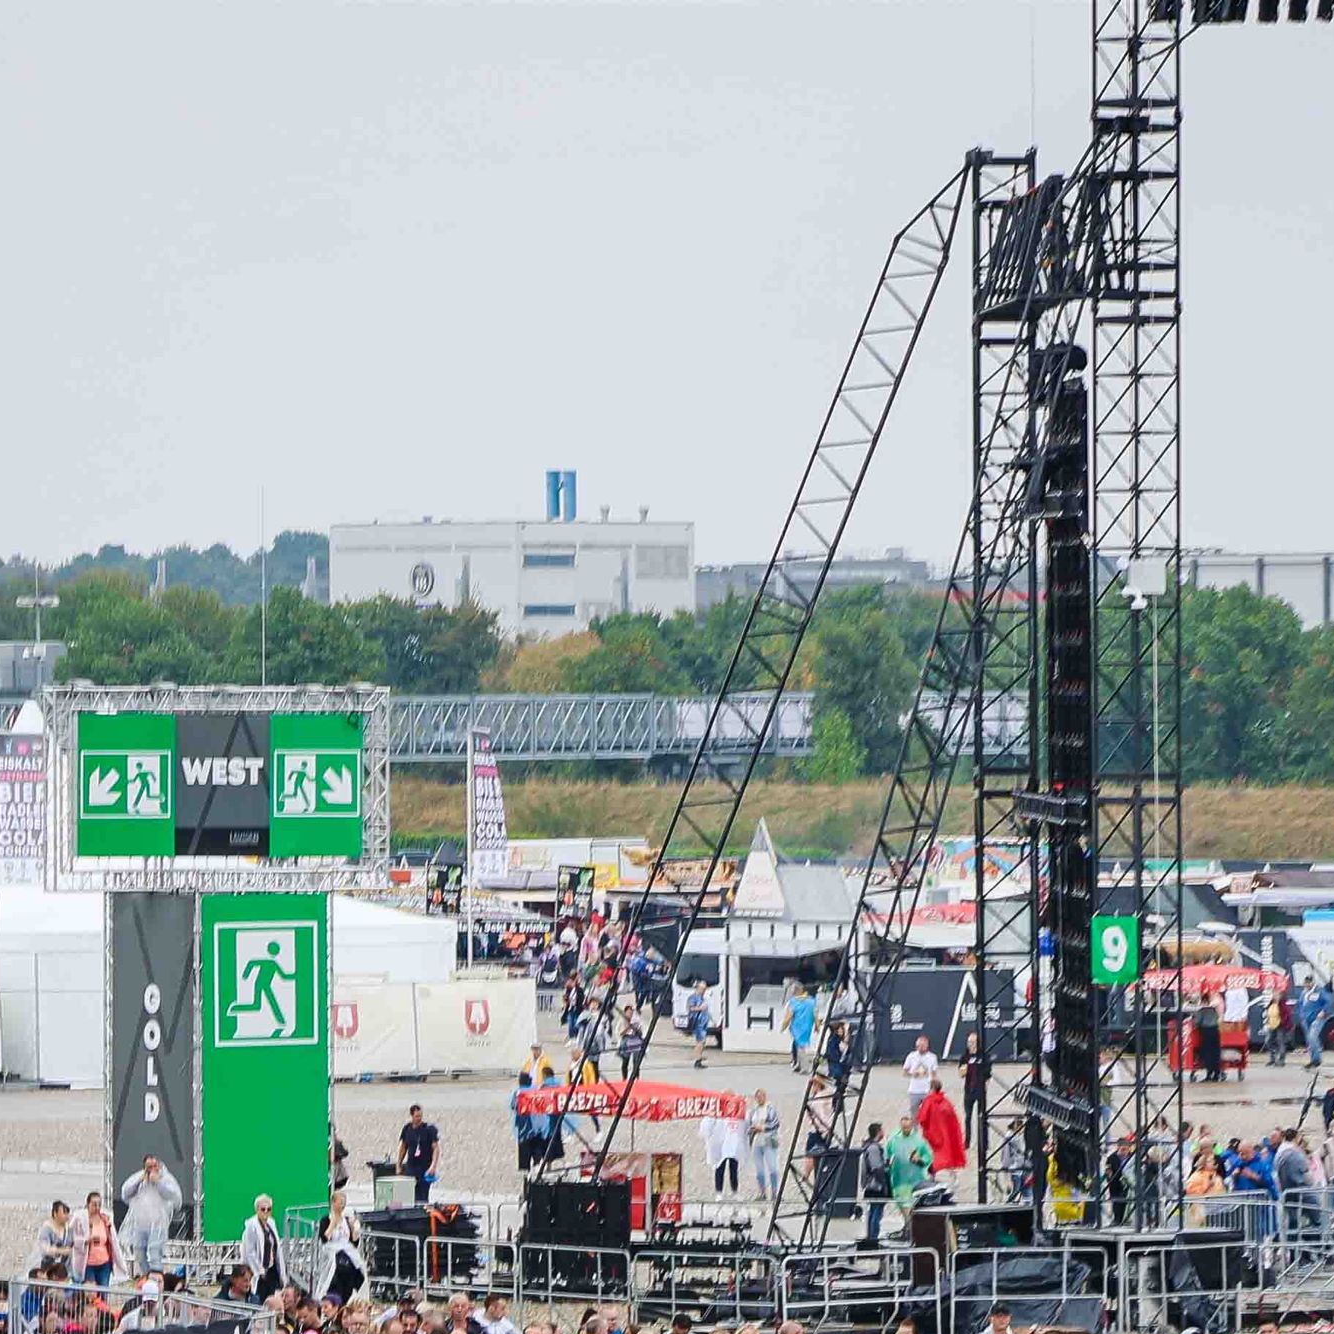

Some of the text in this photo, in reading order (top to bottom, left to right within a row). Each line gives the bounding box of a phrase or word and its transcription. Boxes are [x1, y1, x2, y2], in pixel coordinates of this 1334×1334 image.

[182, 757, 264, 786] WEST
[1102, 926, 1128, 972] 9
[143, 983, 161, 1121] GOLD
[558, 1092, 610, 1114] BREZEL
[676, 1098, 723, 1117] BREZEL
